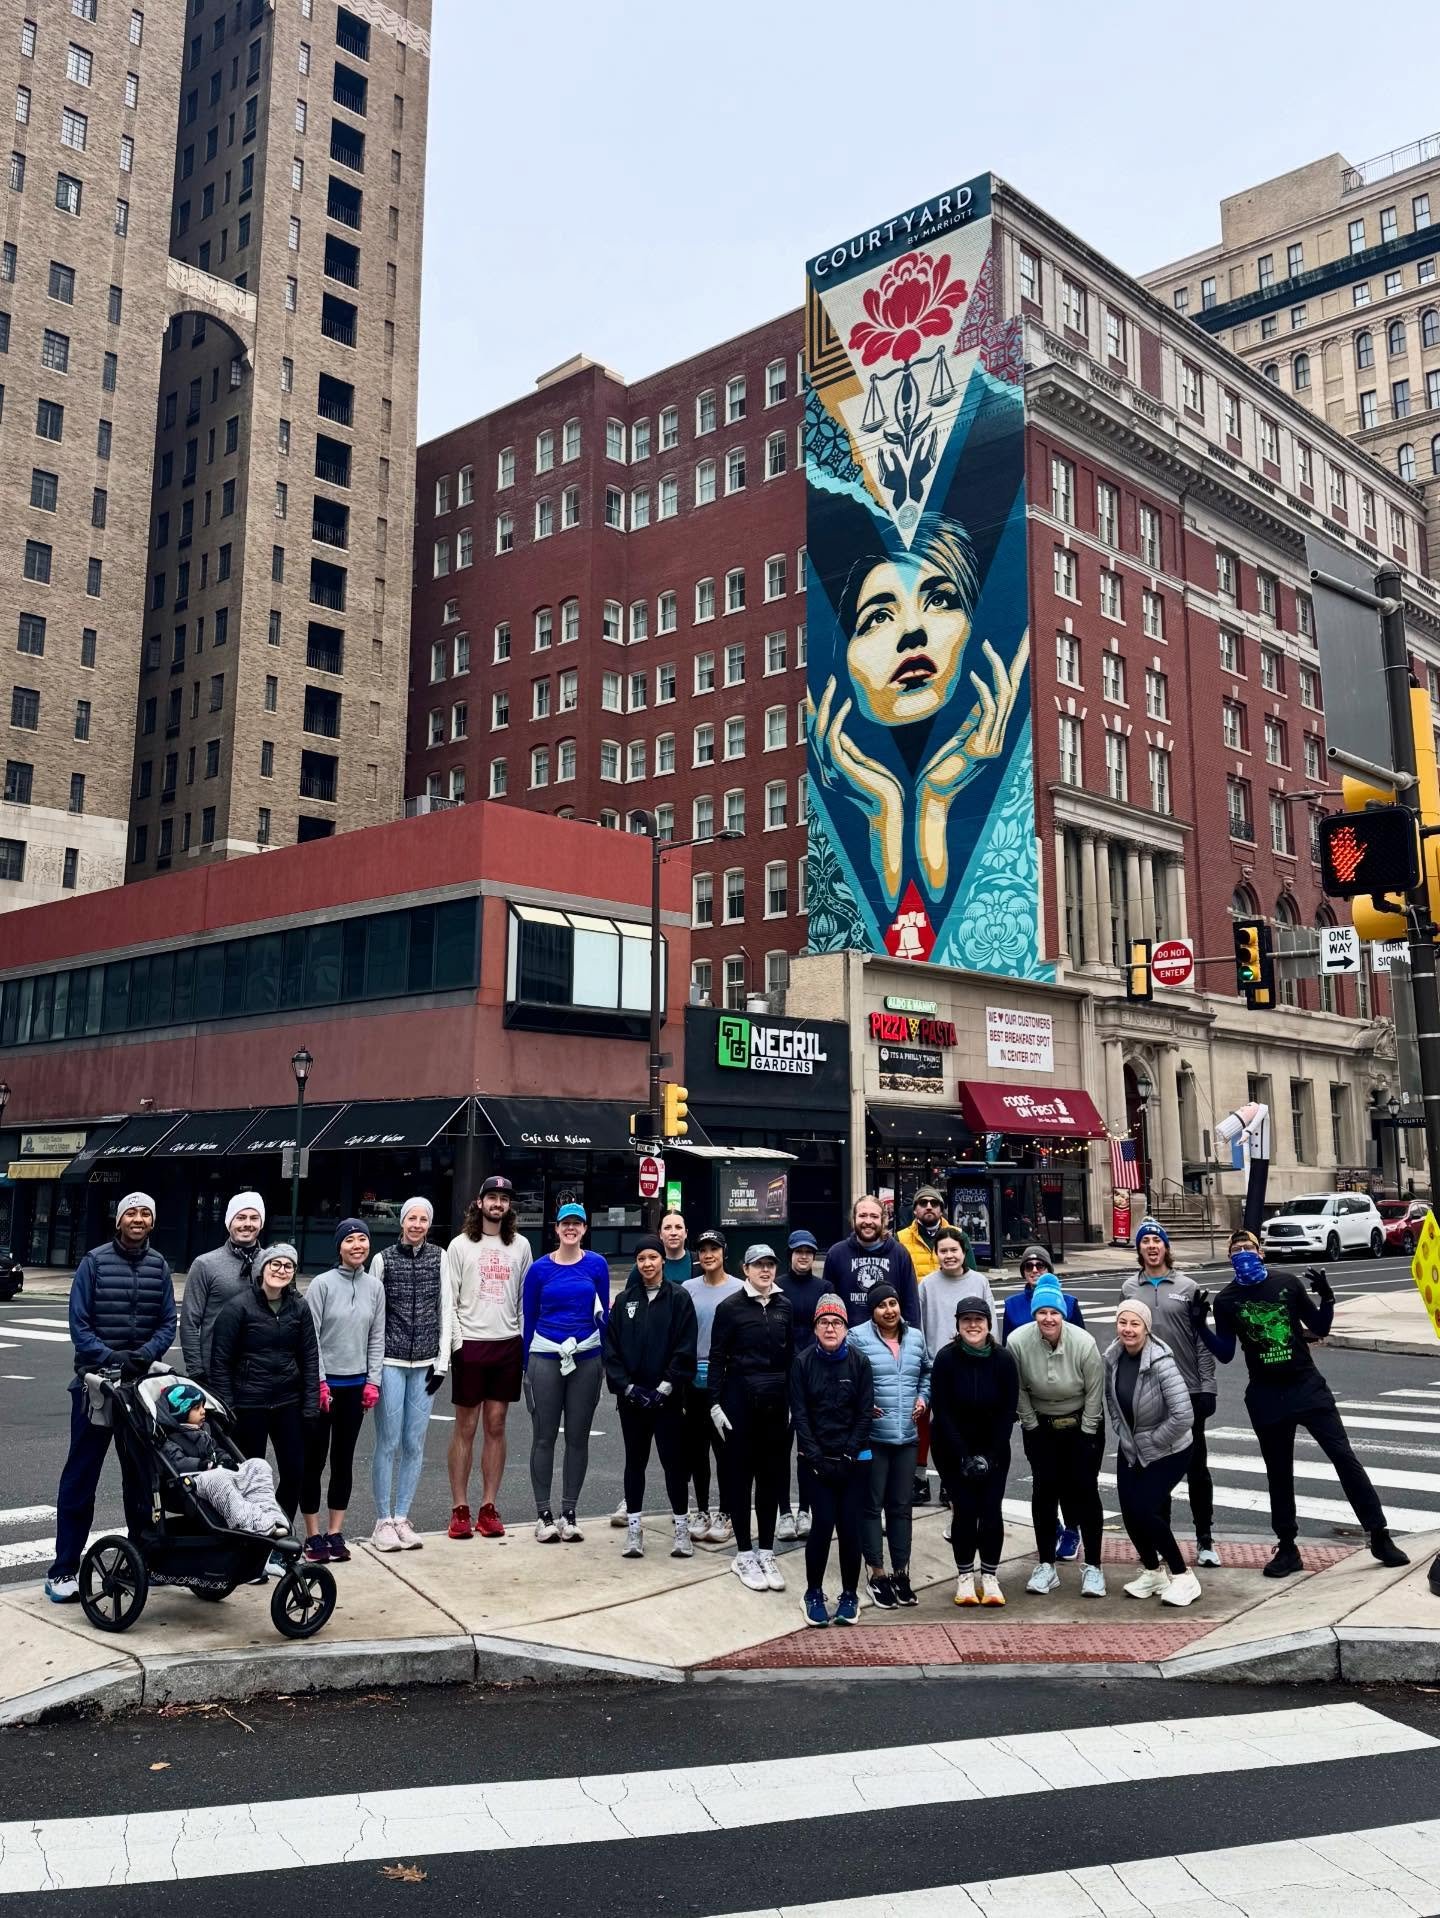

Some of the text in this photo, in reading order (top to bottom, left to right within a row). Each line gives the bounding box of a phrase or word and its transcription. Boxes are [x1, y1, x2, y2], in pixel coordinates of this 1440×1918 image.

[814, 186, 972, 275] COURTYARD
[907, 208, 973, 245] BY MARRIOTT
[1329, 930, 1351, 941] ONE
[1329, 943, 1352, 954] WAY
[1381, 942, 1403, 952] TURN
[1157, 949, 1185, 959] DO NOT
[1160, 968, 1185, 978] ENTER
[988, 1011, 1050, 1030] WE OUR CUSTOMERS
[870, 1012, 958, 1047] PIZZA PASTA
[751, 1026, 827, 1061] NEGRIL
[990, 1030, 1050, 1047] BEST BREAKFAST SPOT
[905, 1053, 921, 1061] PHILLY
[1000, 1050, 1042, 1064] IN CENTER CITY
[755, 1058, 811, 1073] GARDENS
[1003, 1095, 1034, 1107] FOODS
[1017, 1104, 1057, 1117] ON FIRST
[521, 1132, 592, 1145] Cafe Old Nelson
[732, 1189, 755, 1197] EVERY DAY
[749, 1199, 757, 1207] DAY
